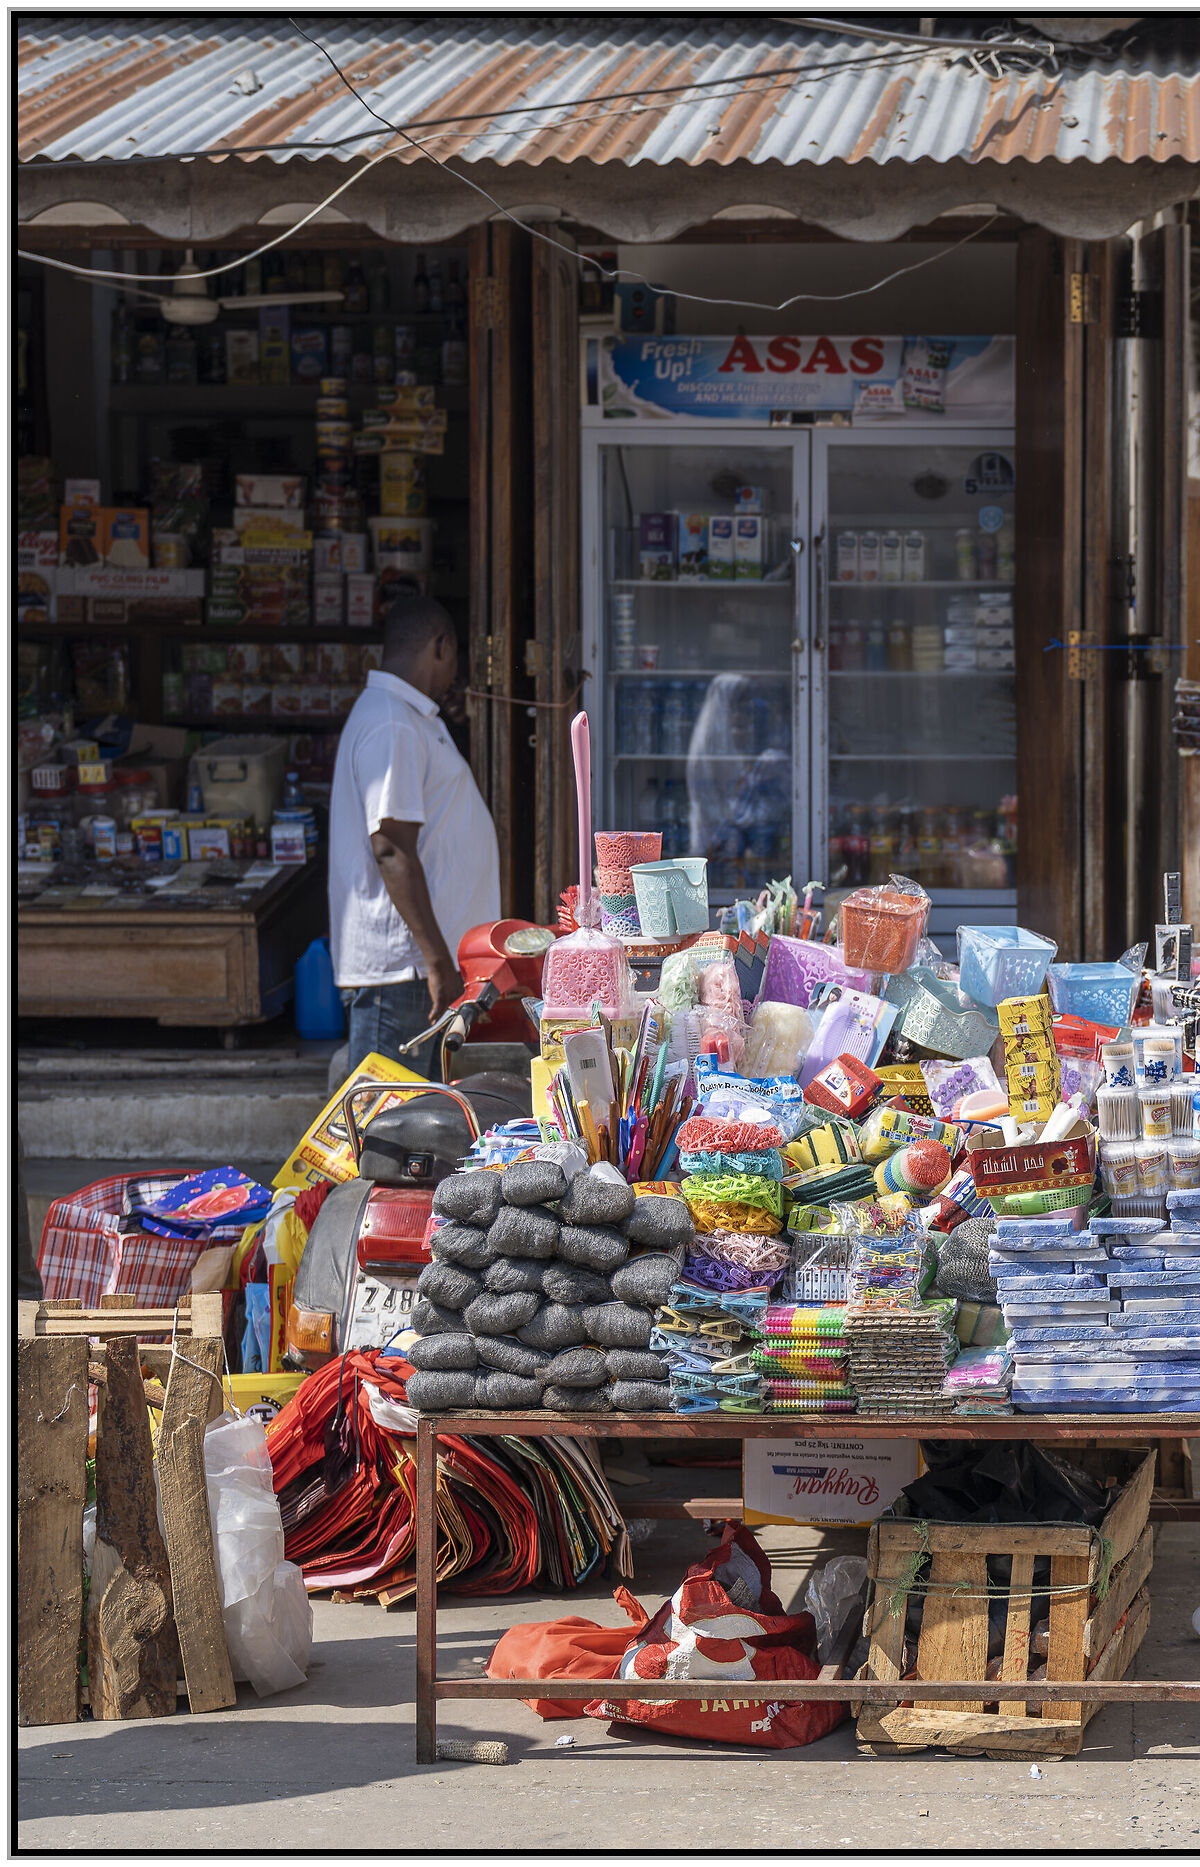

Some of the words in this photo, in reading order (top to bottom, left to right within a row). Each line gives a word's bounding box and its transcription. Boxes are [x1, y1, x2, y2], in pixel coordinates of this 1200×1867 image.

[640, 339, 702, 361] Fresh
[718, 335, 885, 374] ASAS
[655, 357, 693, 382] Up!
[831, 1441, 864, 1450] CONTENT:
[794, 1468, 880, 1505] Rayyan
